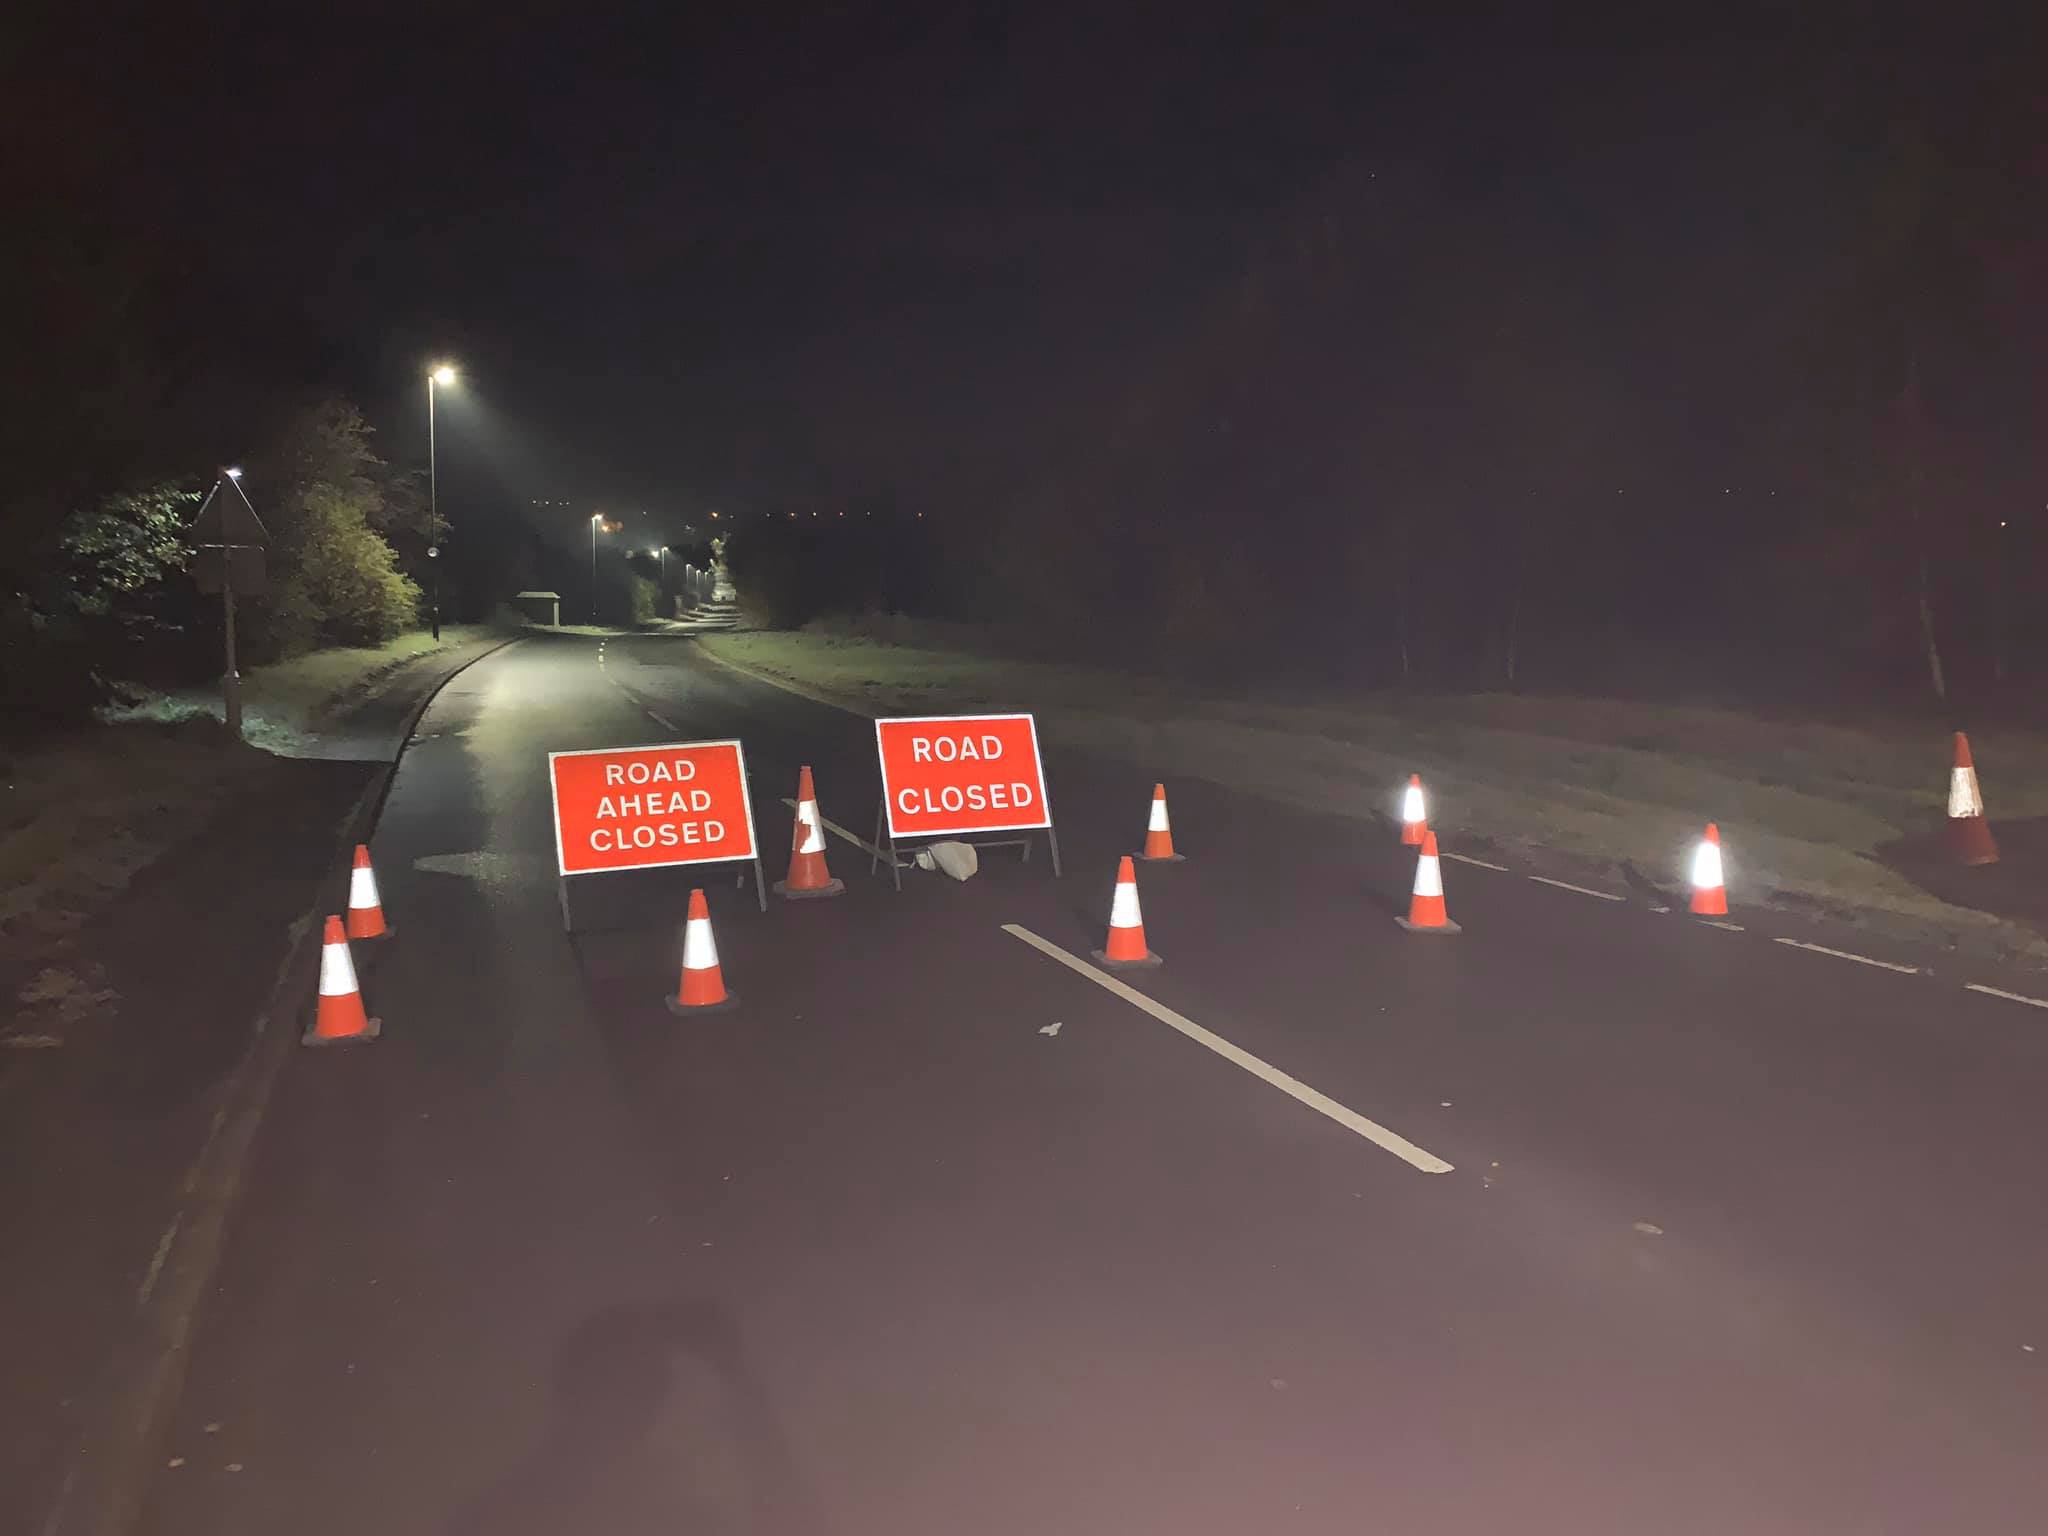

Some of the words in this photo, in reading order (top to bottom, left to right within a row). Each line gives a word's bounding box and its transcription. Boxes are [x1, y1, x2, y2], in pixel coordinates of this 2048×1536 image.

[912, 735, 1003, 763] ROAD
[605, 759, 696, 786] ROAD
[595, 789, 712, 820] AHEAD
[898, 782, 1033, 815] CLOSED
[589, 820, 725, 852] CLOSED
